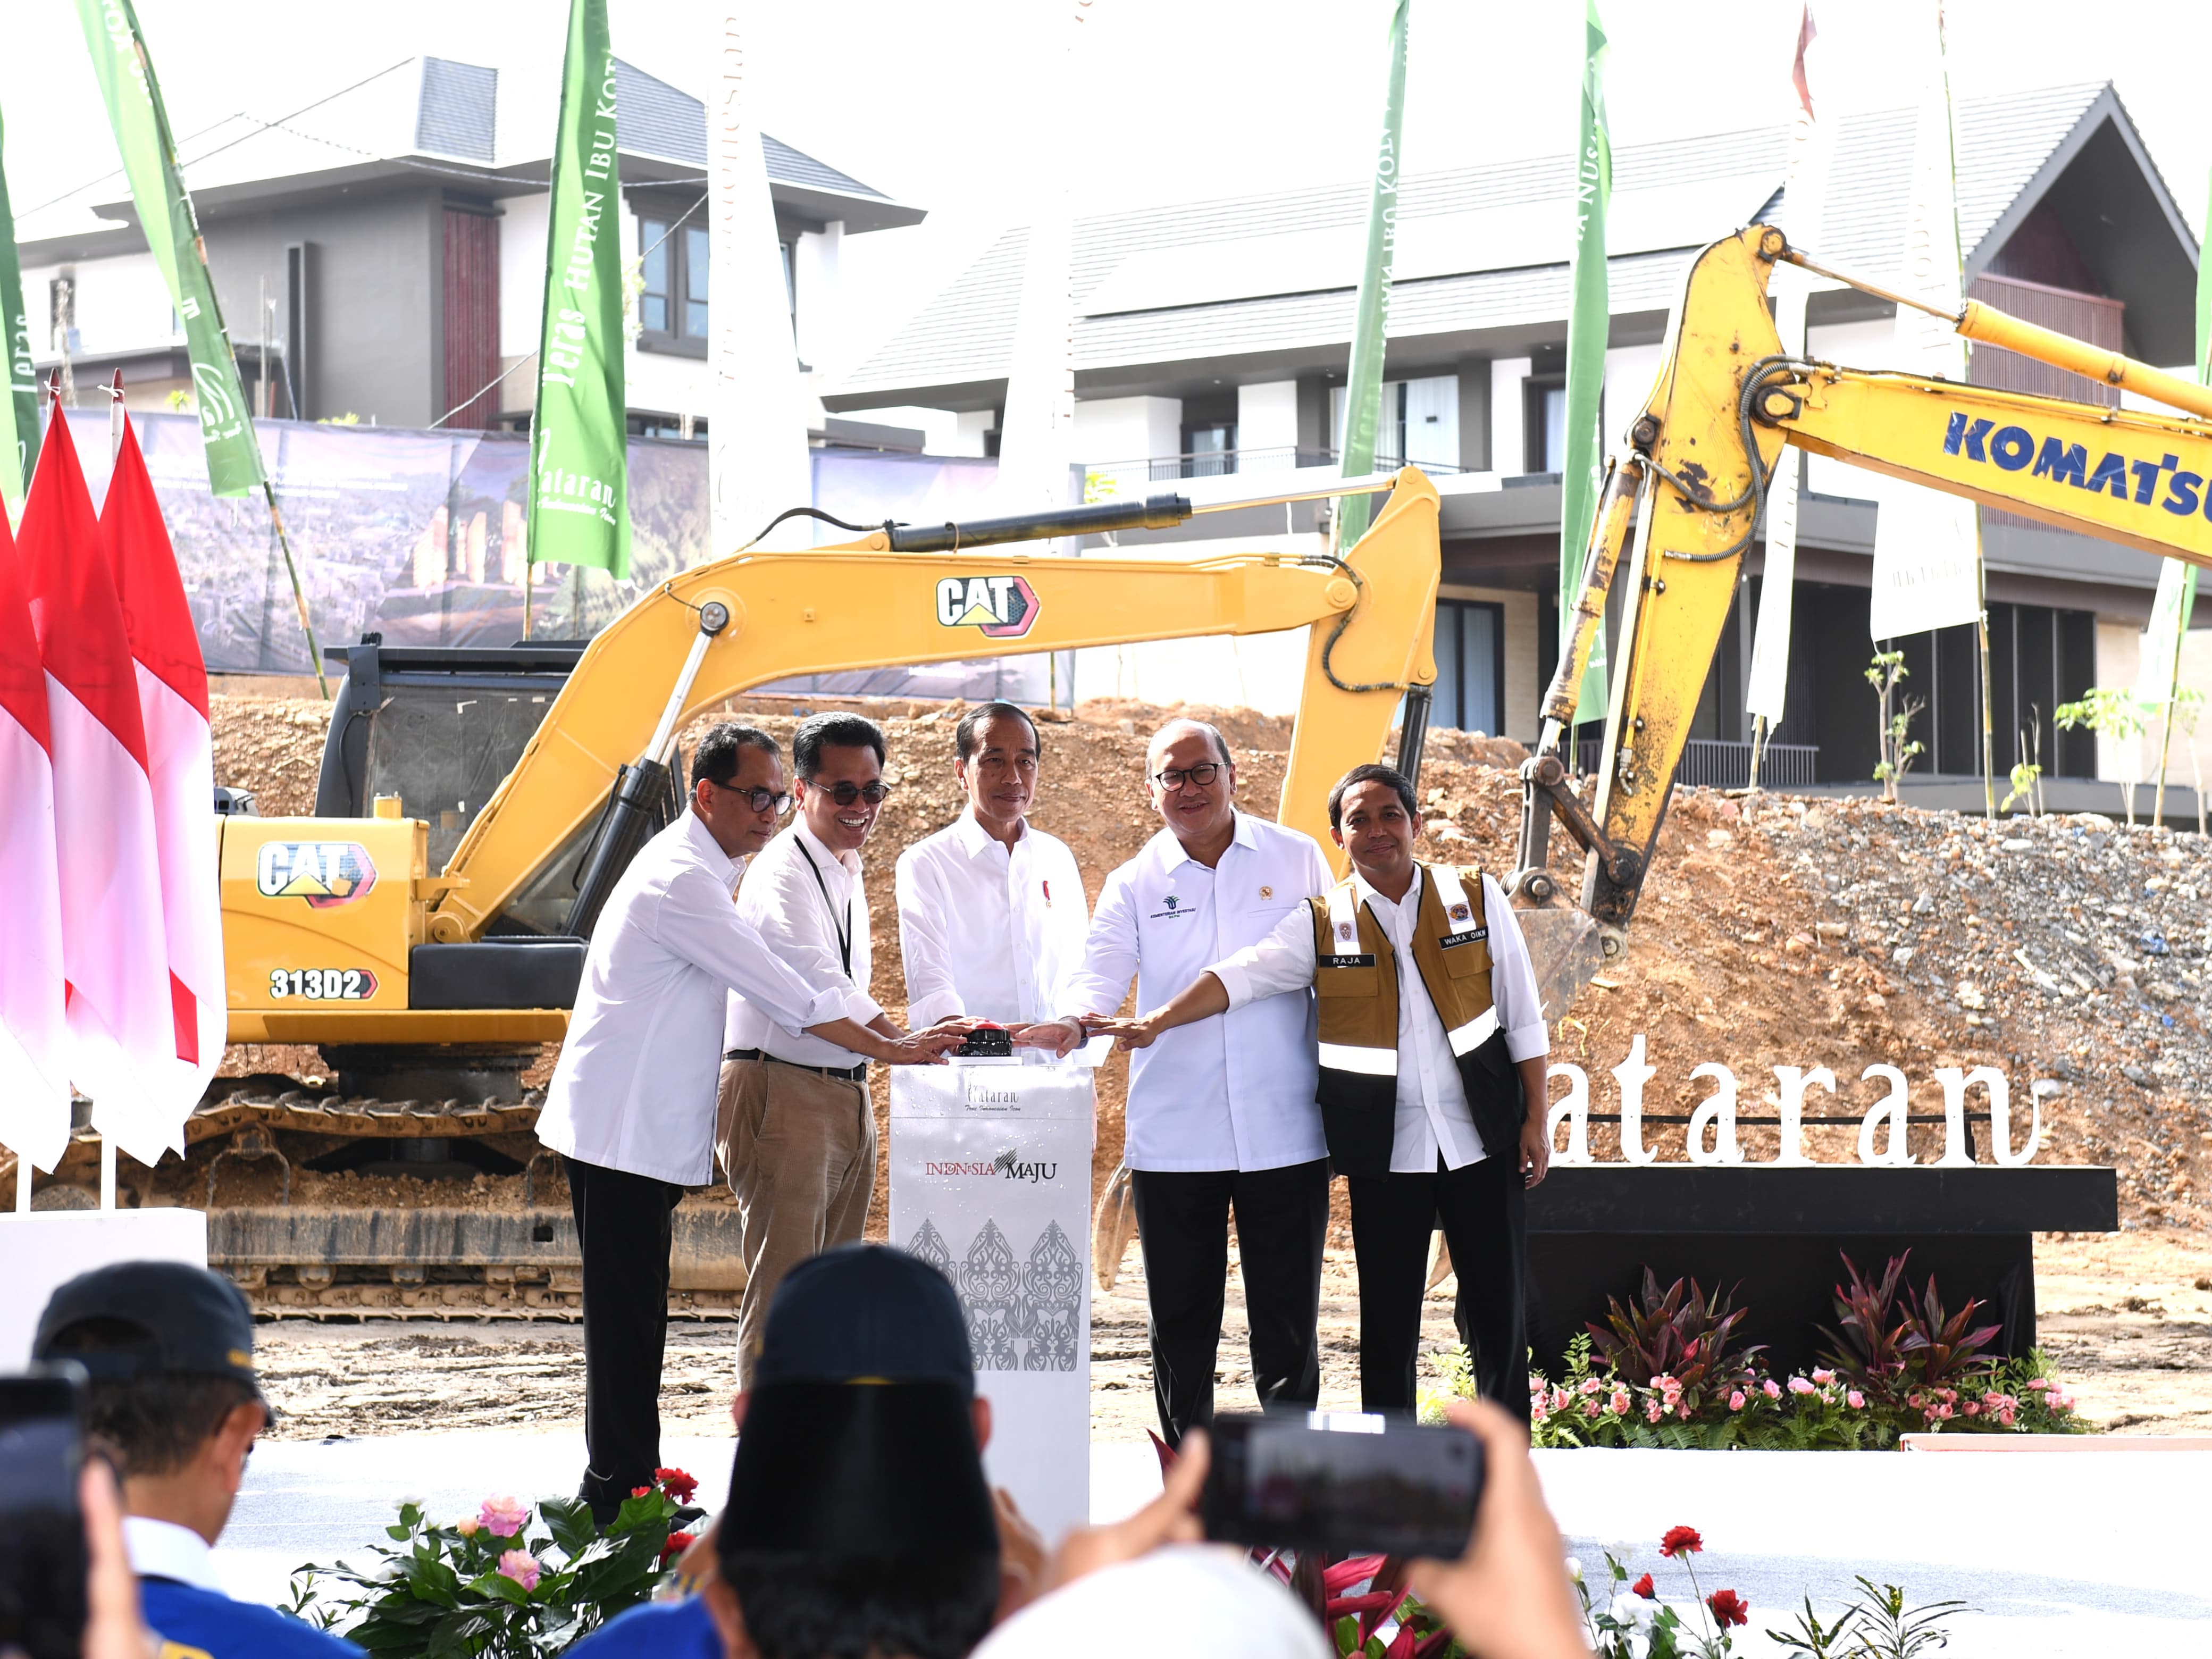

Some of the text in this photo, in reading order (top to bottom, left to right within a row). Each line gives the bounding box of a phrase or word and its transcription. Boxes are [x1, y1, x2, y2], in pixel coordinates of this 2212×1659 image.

[541, 308, 586, 388] Teras
[564, 190, 605, 291] HUTAN
[585, 131, 615, 180] IBU
[538, 467, 616, 508] ataran
[1943, 409, 2212, 524] KOMATS
[937, 576, 1014, 626] CAT
[259, 843, 349, 895] CAT
[1444, 934, 1468, 945] WAKA
[271, 969, 362, 999] 313D2
[1546, 1034, 2040, 1166] ataran
[1004, 1162, 1058, 1184] MAJU
